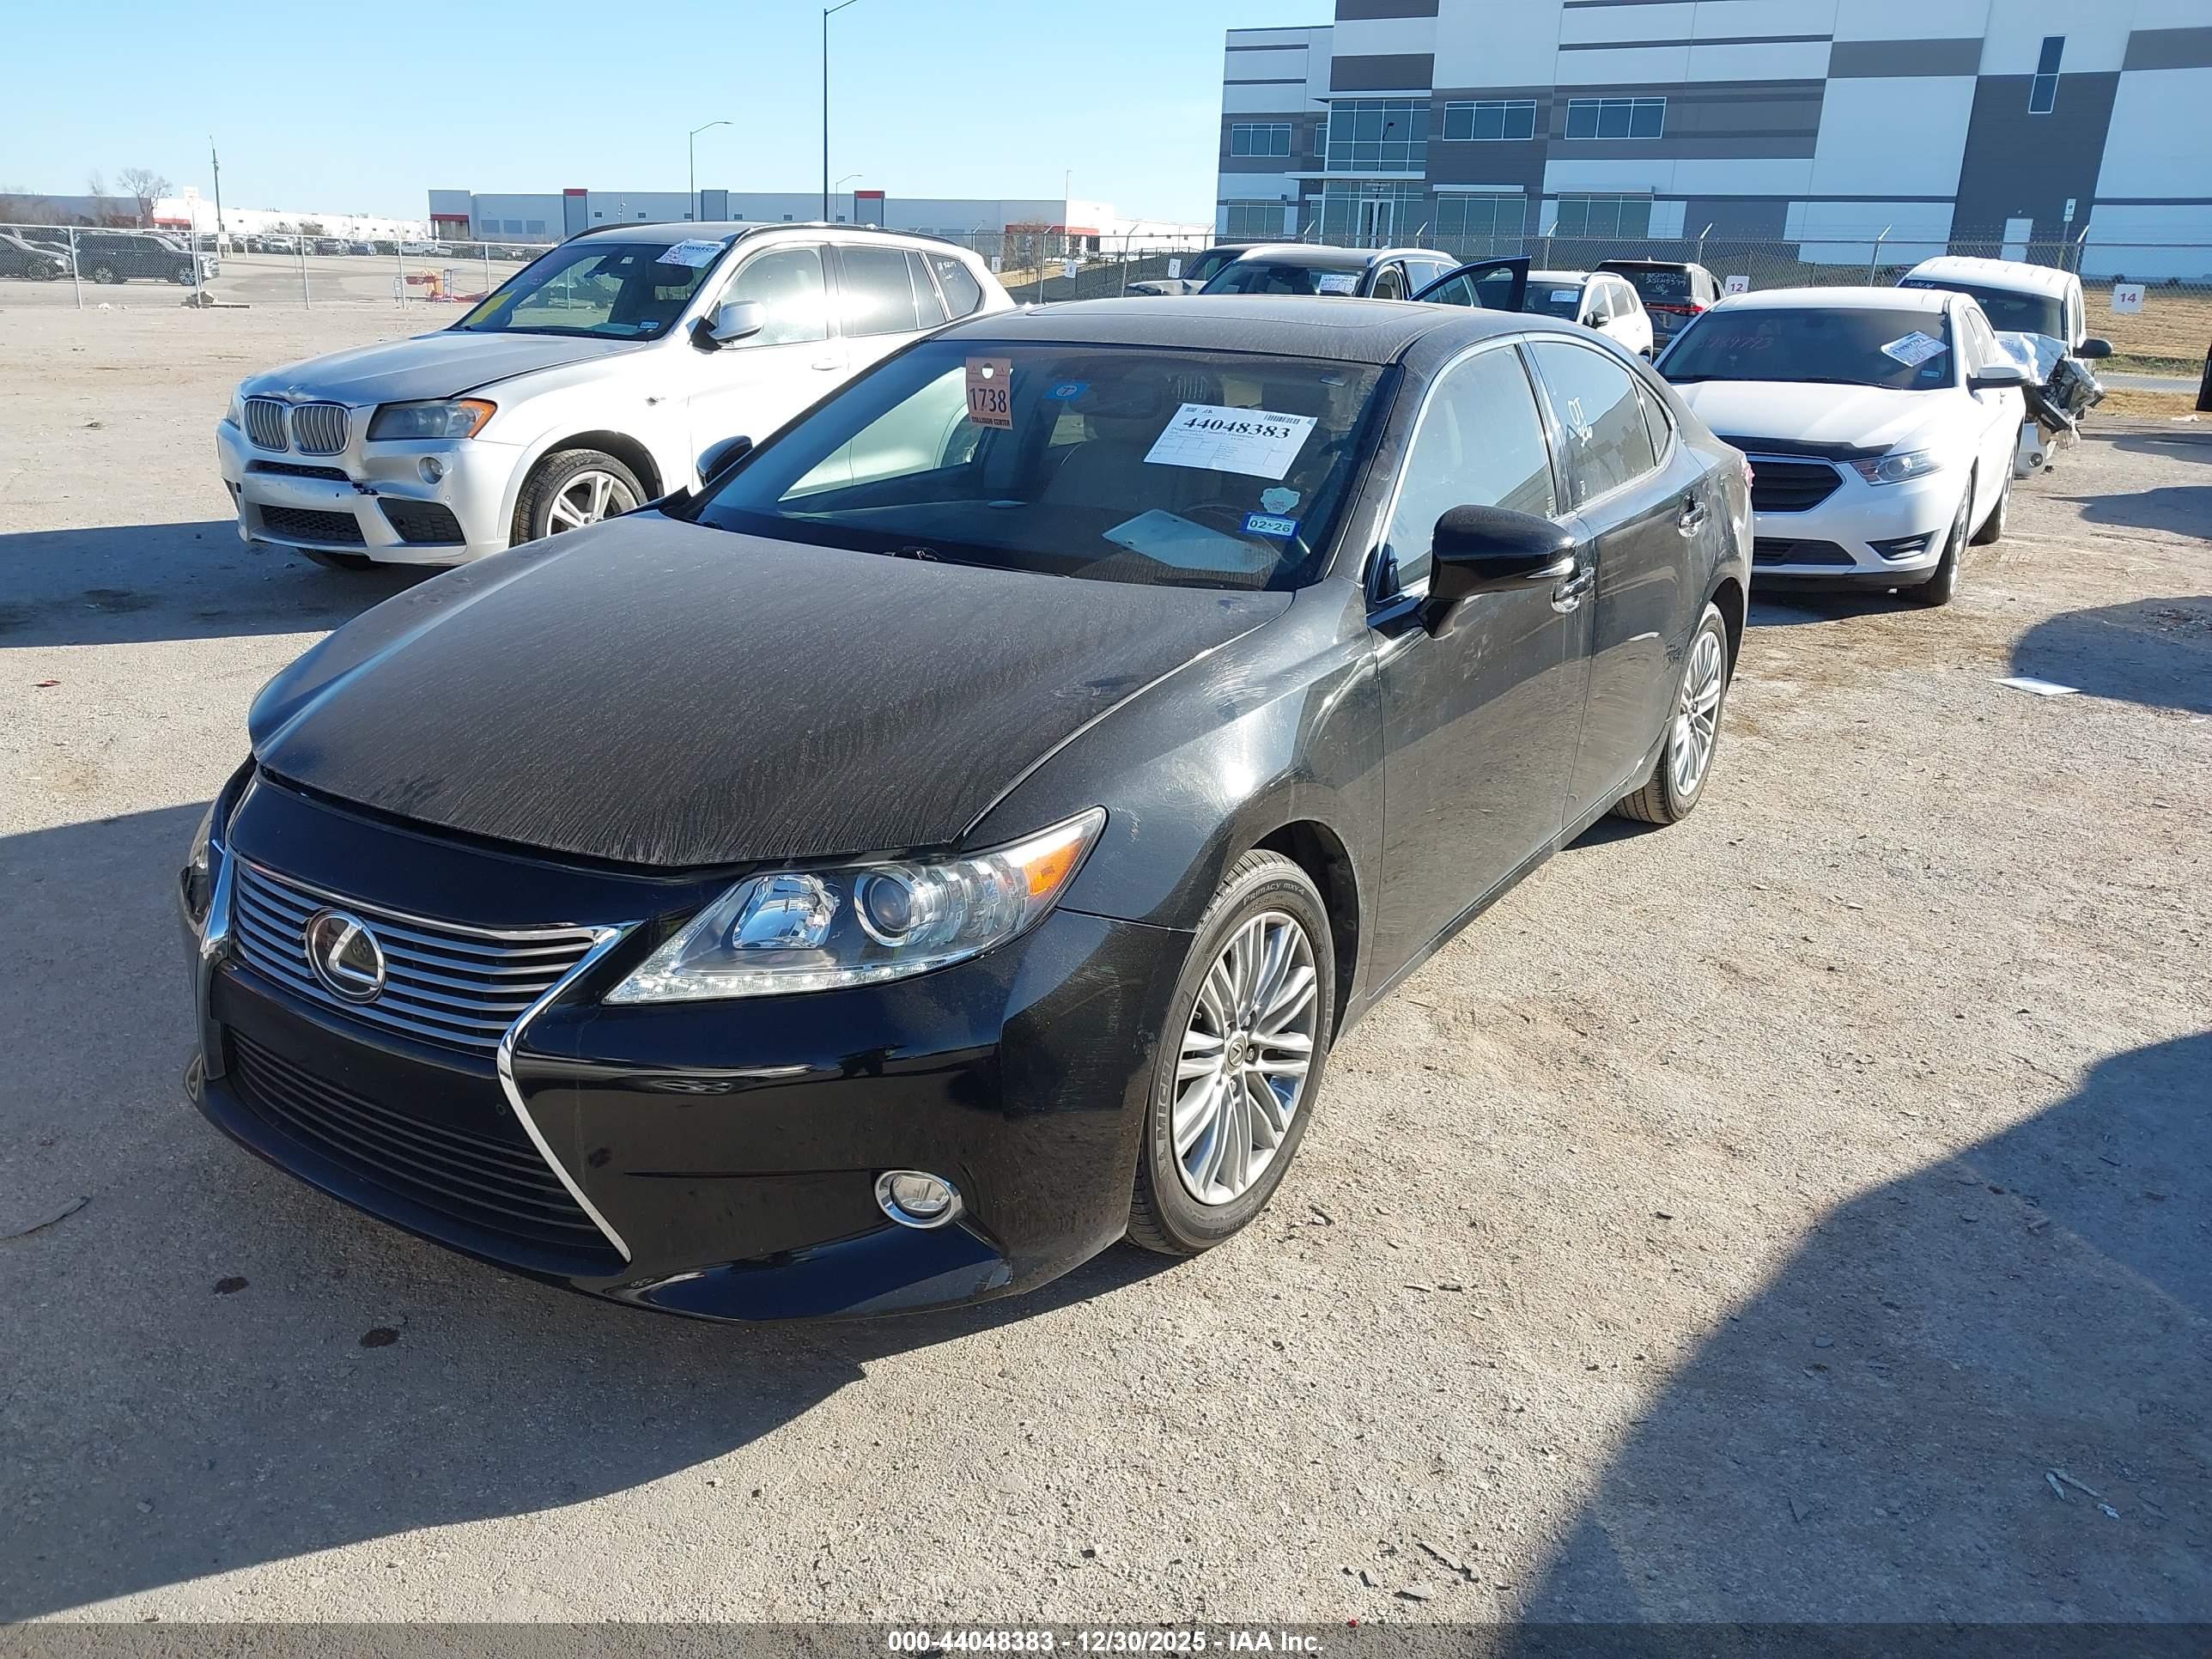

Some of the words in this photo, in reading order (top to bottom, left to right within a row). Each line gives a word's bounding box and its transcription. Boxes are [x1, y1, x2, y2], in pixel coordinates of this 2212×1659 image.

[2120, 293, 2136, 302] 14
[969, 387, 1007, 413] 1738
[994, 418, 1010, 427] CENTER
[1183, 417, 1291, 439] 44048383
